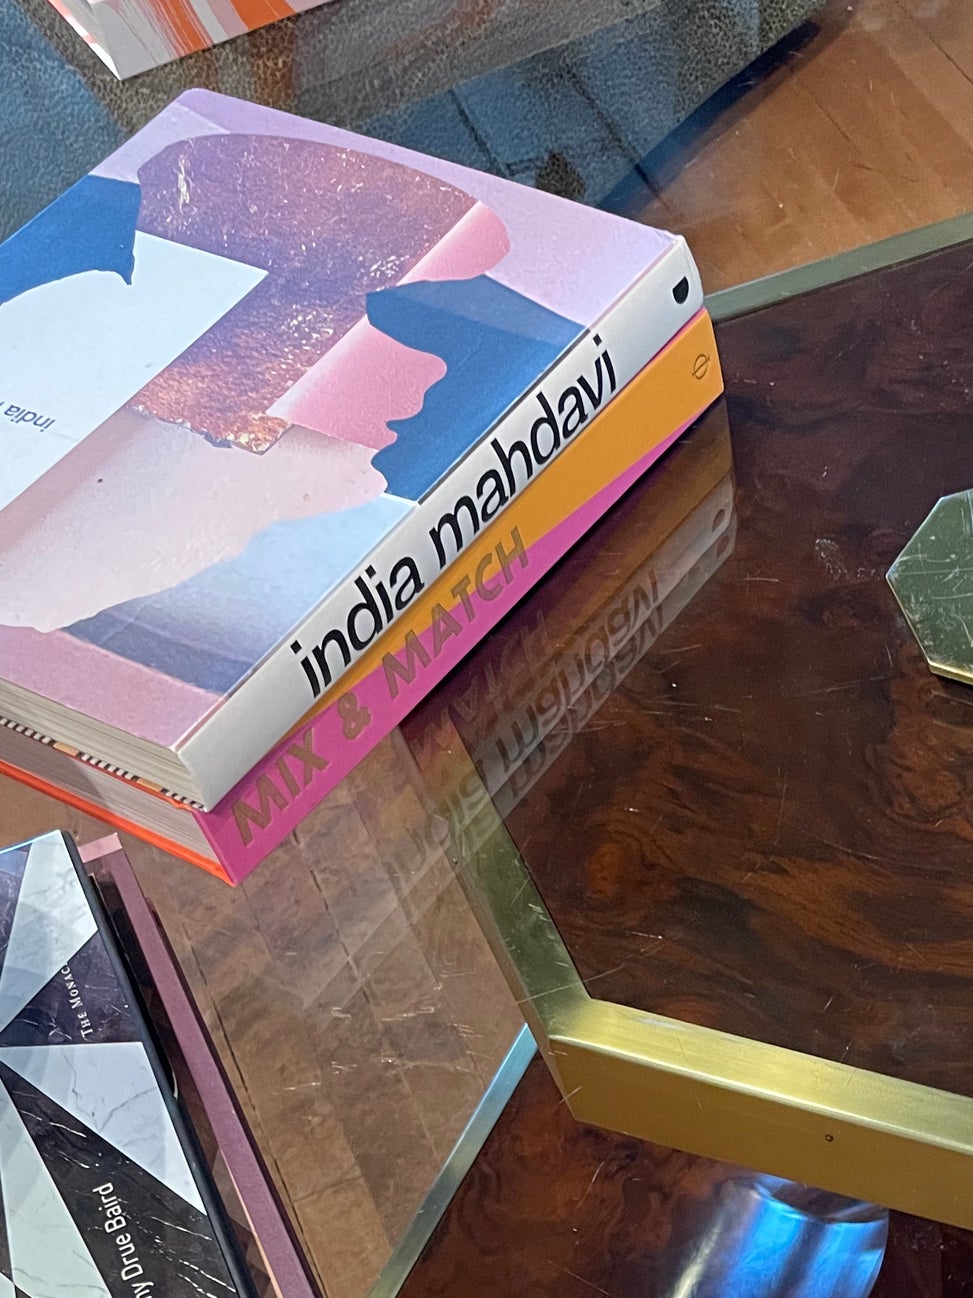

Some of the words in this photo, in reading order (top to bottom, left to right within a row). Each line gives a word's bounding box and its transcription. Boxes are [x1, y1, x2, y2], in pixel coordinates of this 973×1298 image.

[4, 404, 56, 432] india
[290, 556, 425, 699] india
[428, 335, 617, 569] mahdavi
[231, 727, 329, 847] MIX
[336, 691, 372, 740] &
[381, 525, 529, 699] MATCH
[77, 1011, 93, 1038] THE
[92, 1182, 127, 1233] Baird
[115, 1232, 144, 1281] Drue
